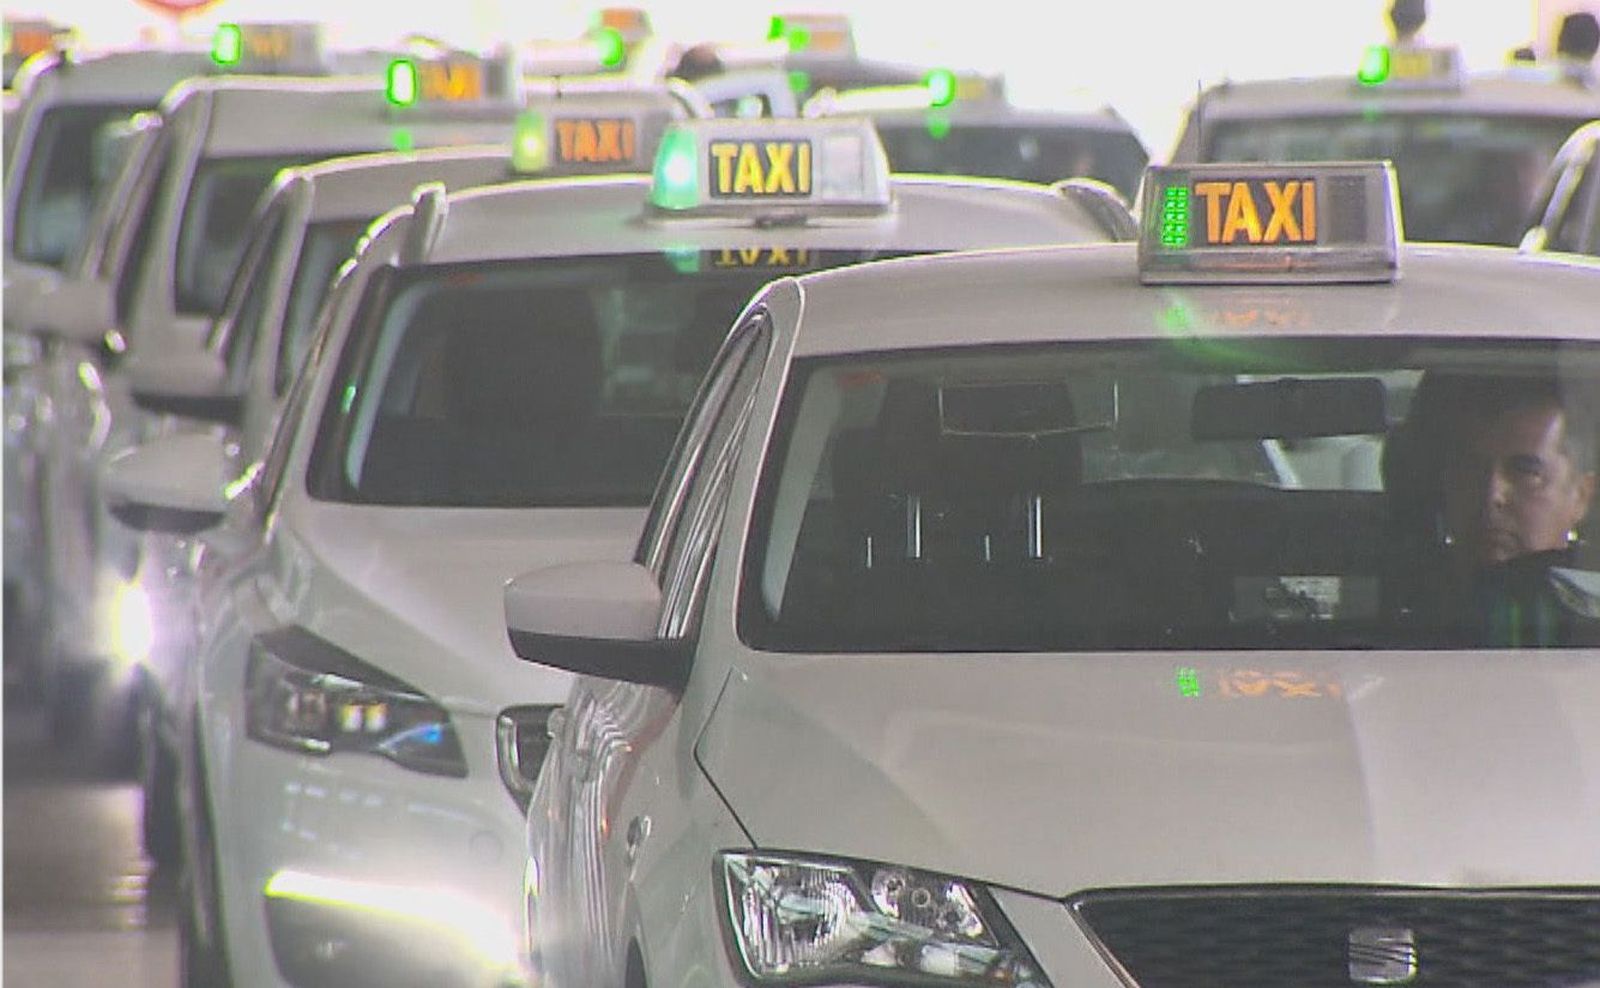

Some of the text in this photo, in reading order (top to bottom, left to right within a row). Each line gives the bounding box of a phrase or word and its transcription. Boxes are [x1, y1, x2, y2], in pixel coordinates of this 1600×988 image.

[555, 119, 634, 162] TAXI
[711, 142, 811, 194] TAXI
[1195, 181, 1316, 243] TAXI
